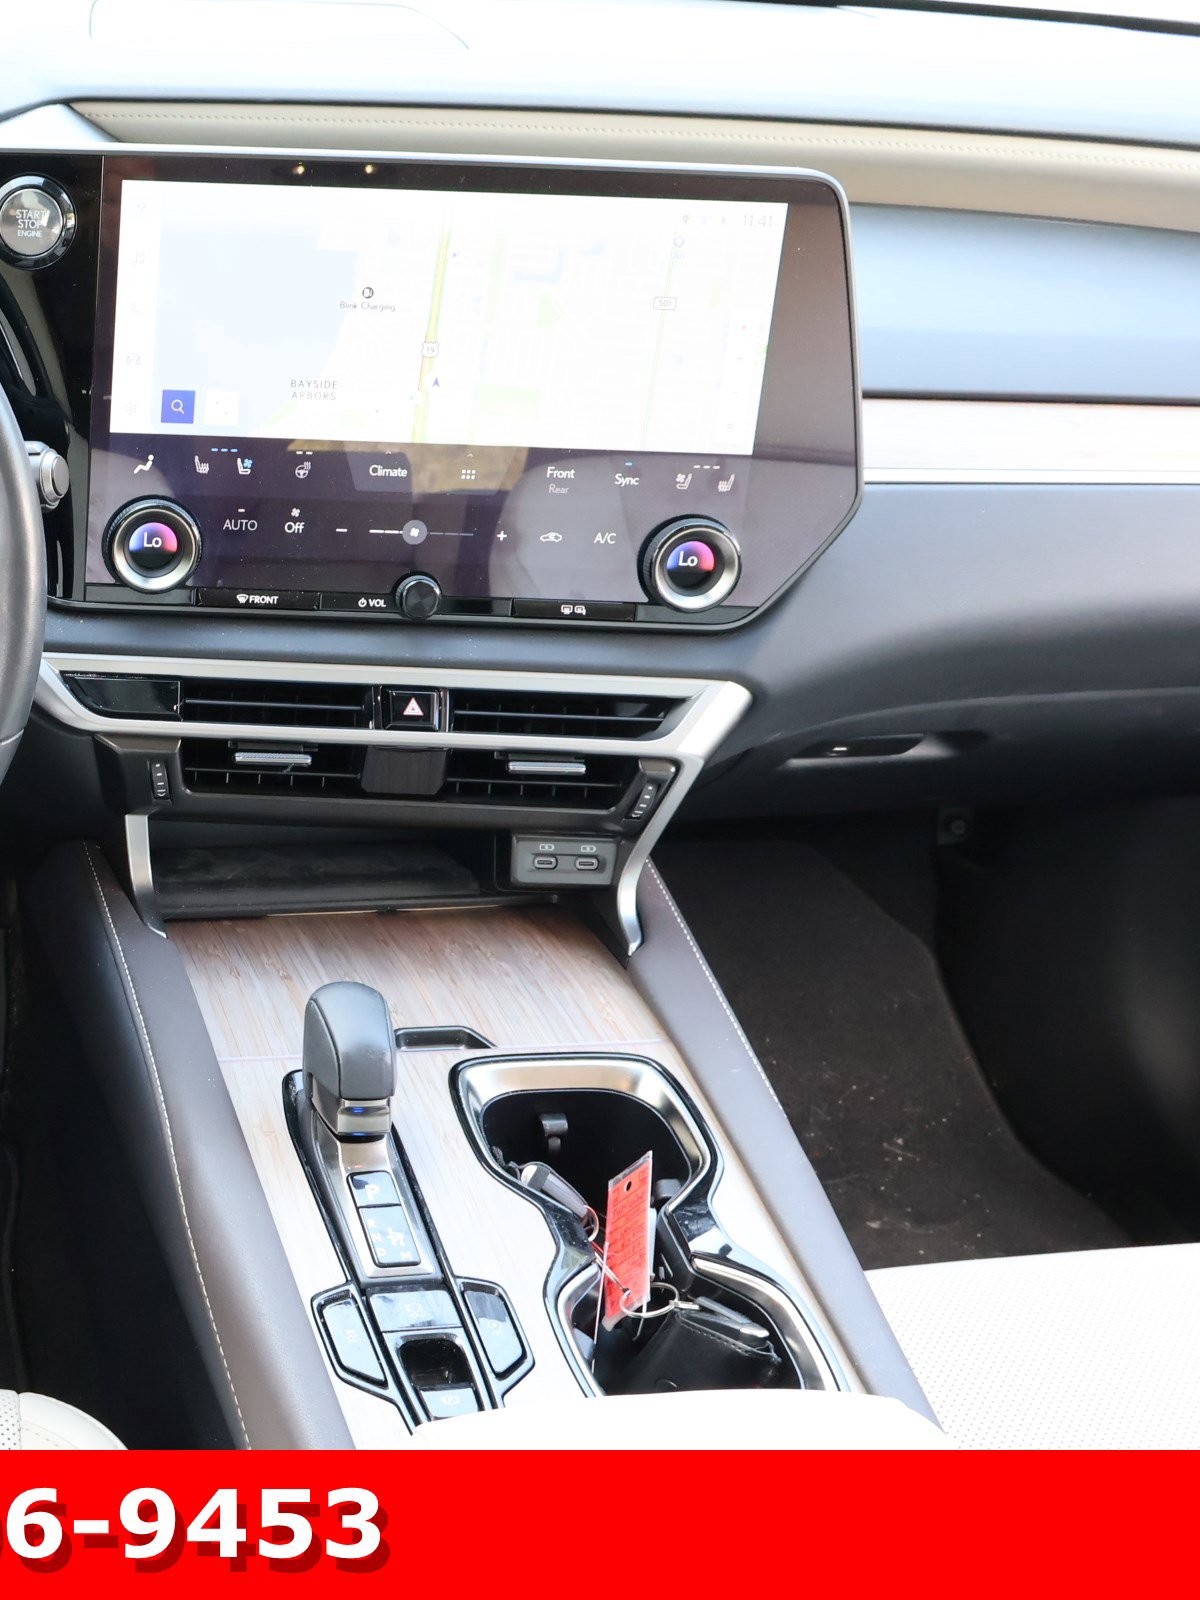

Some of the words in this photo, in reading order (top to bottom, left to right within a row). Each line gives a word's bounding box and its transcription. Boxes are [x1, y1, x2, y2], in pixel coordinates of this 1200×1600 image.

[18, 220, 43, 229] STOP
[17, 230, 43, 238] ENGINE
[360, 302, 396, 312] Charging
[425, 346, 435, 354] 19
[290, 379, 339, 389] BAYSIDE
[291, 391, 336, 400] ARBORS
[369, 464, 408, 477] Climate
[546, 467, 575, 479] Front
[614, 473, 640, 488] Sync
[548, 484, 569, 494] Rear
[223, 519, 258, 531] AUTO
[284, 522, 305, 534] Off
[143, 532, 162, 548] Lo
[594, 532, 617, 545] A/C
[679, 551, 698, 567] Lo
[249, 595, 279, 605] FRONT
[369, 598, 387, 608] VOL
